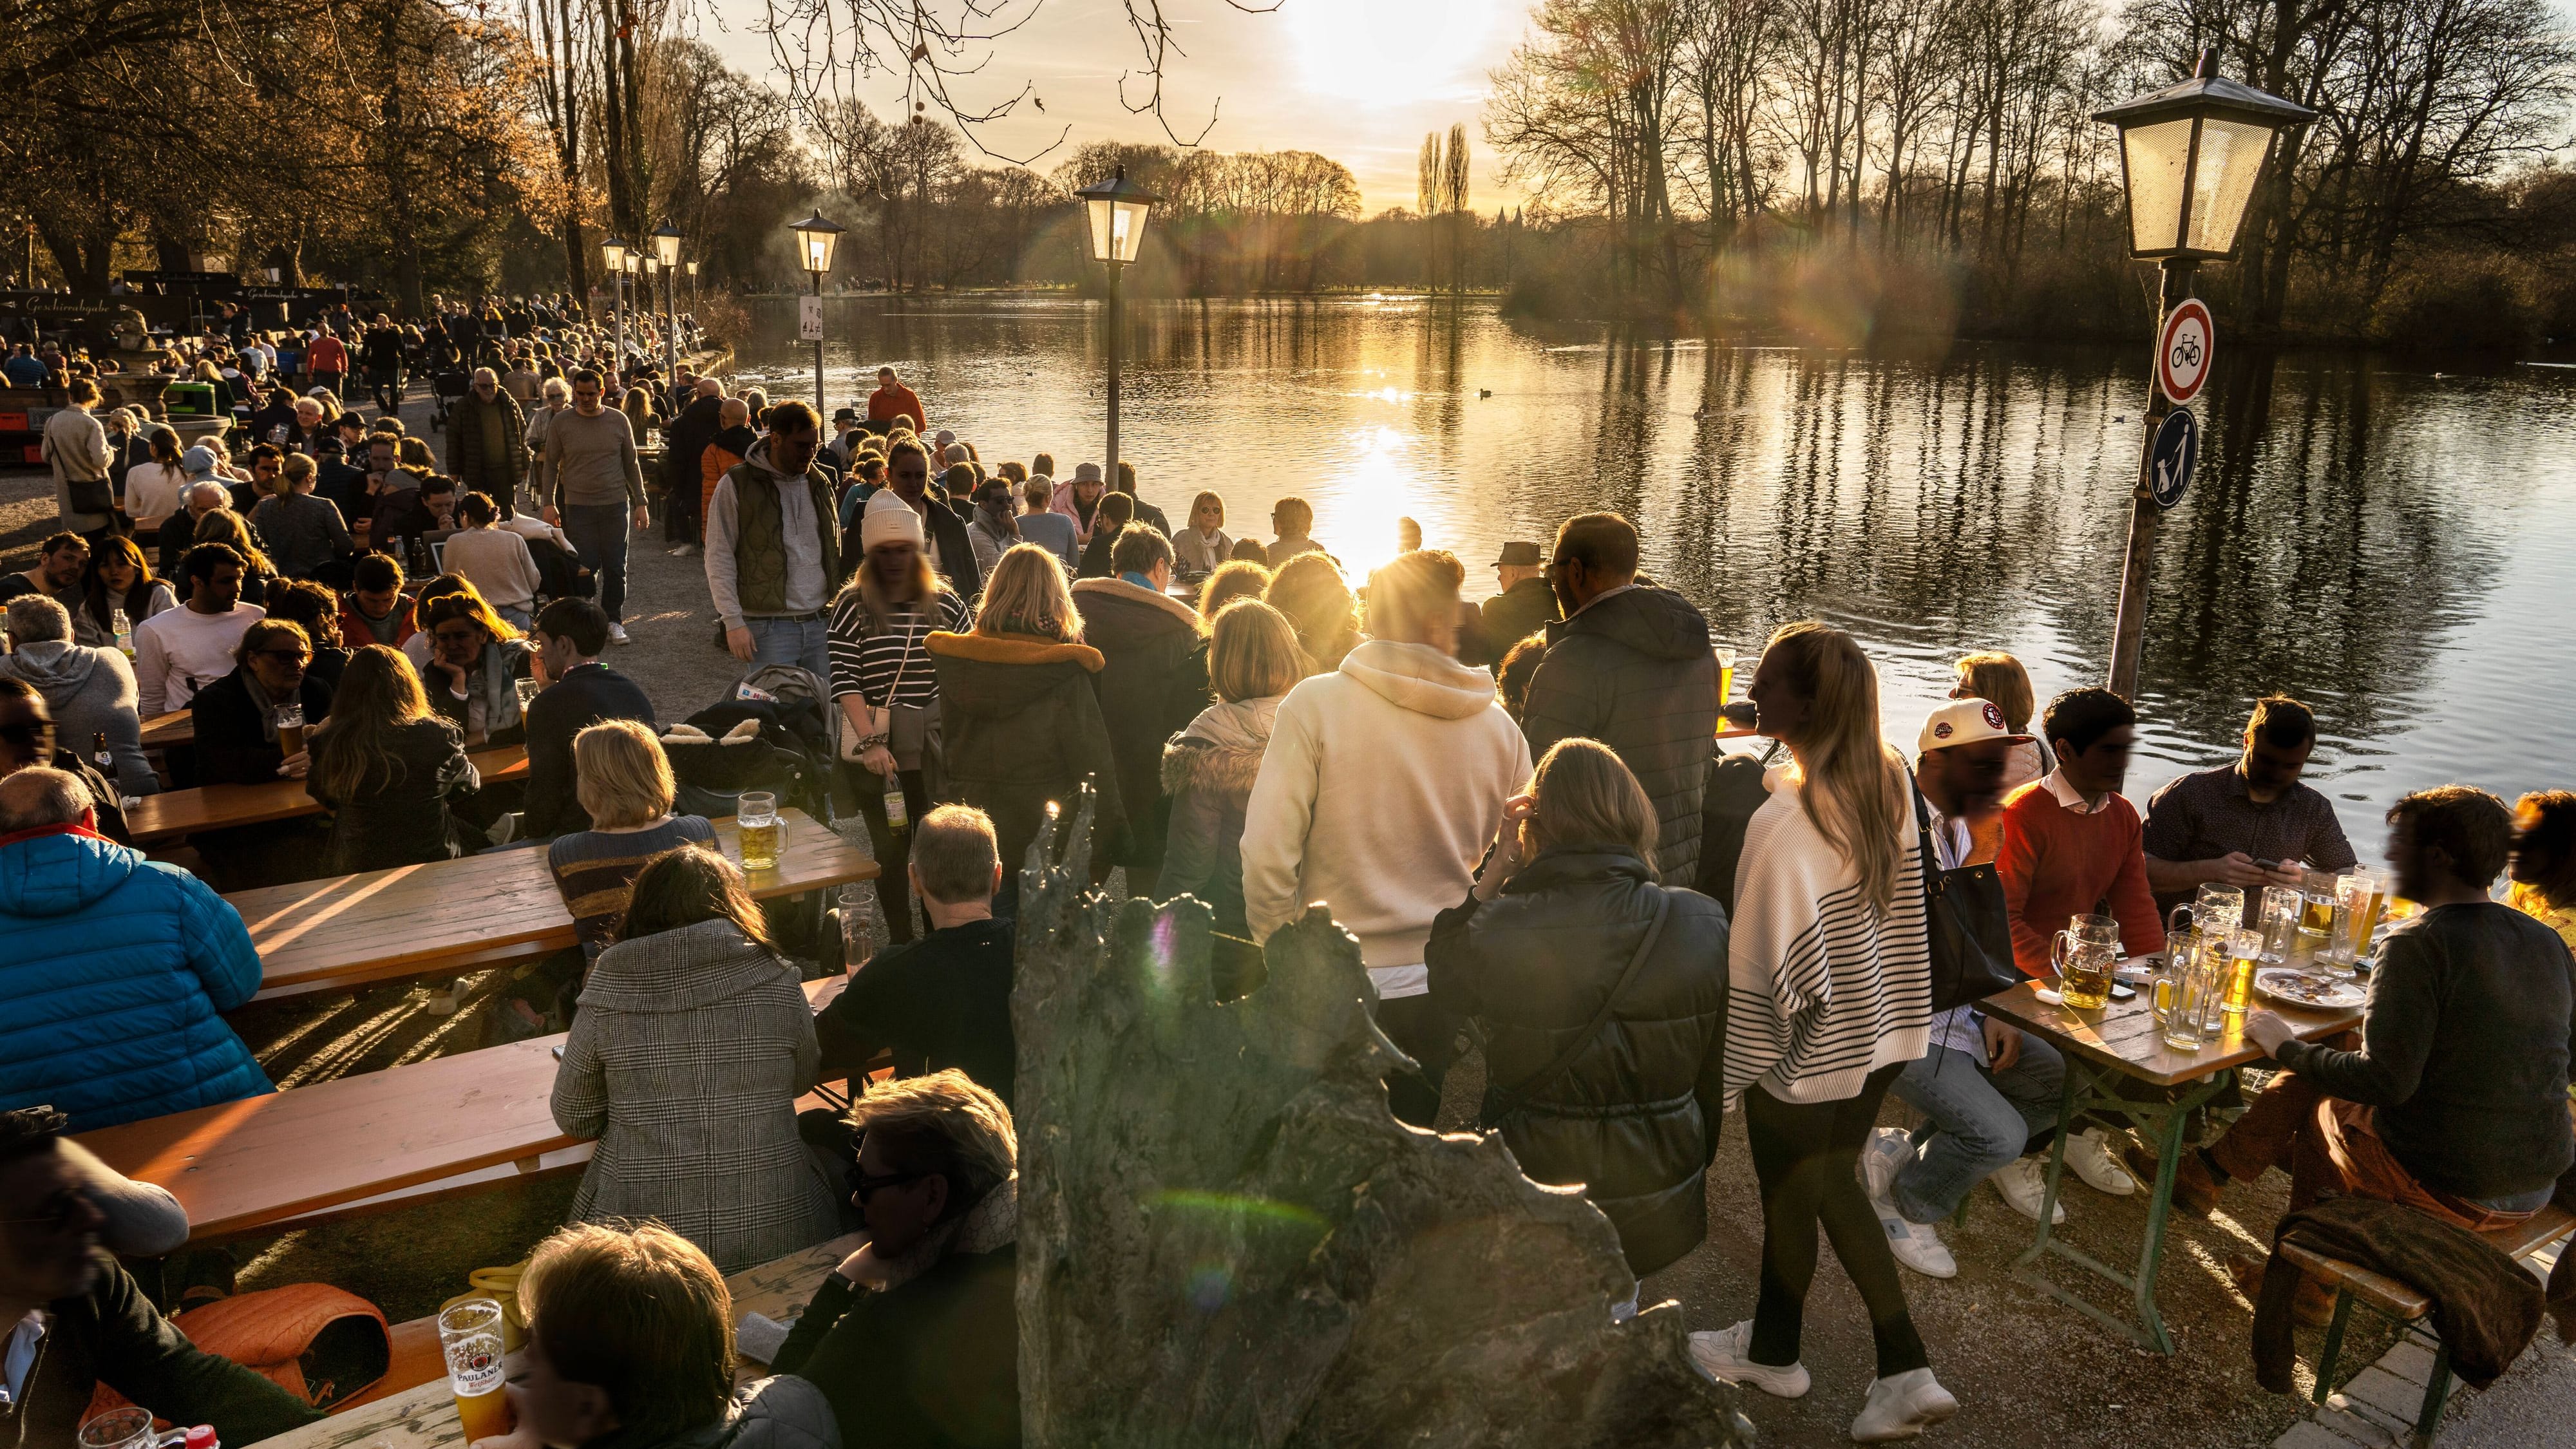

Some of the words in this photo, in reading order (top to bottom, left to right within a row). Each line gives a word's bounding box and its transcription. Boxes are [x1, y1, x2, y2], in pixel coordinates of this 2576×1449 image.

[248, 288, 298, 300] Geschirrabgabe
[26, 296, 109, 316] Geschirrabgabe
[458, 1361, 502, 1381] PAULANER
[469, 1376, 497, 1388] Weißbier
